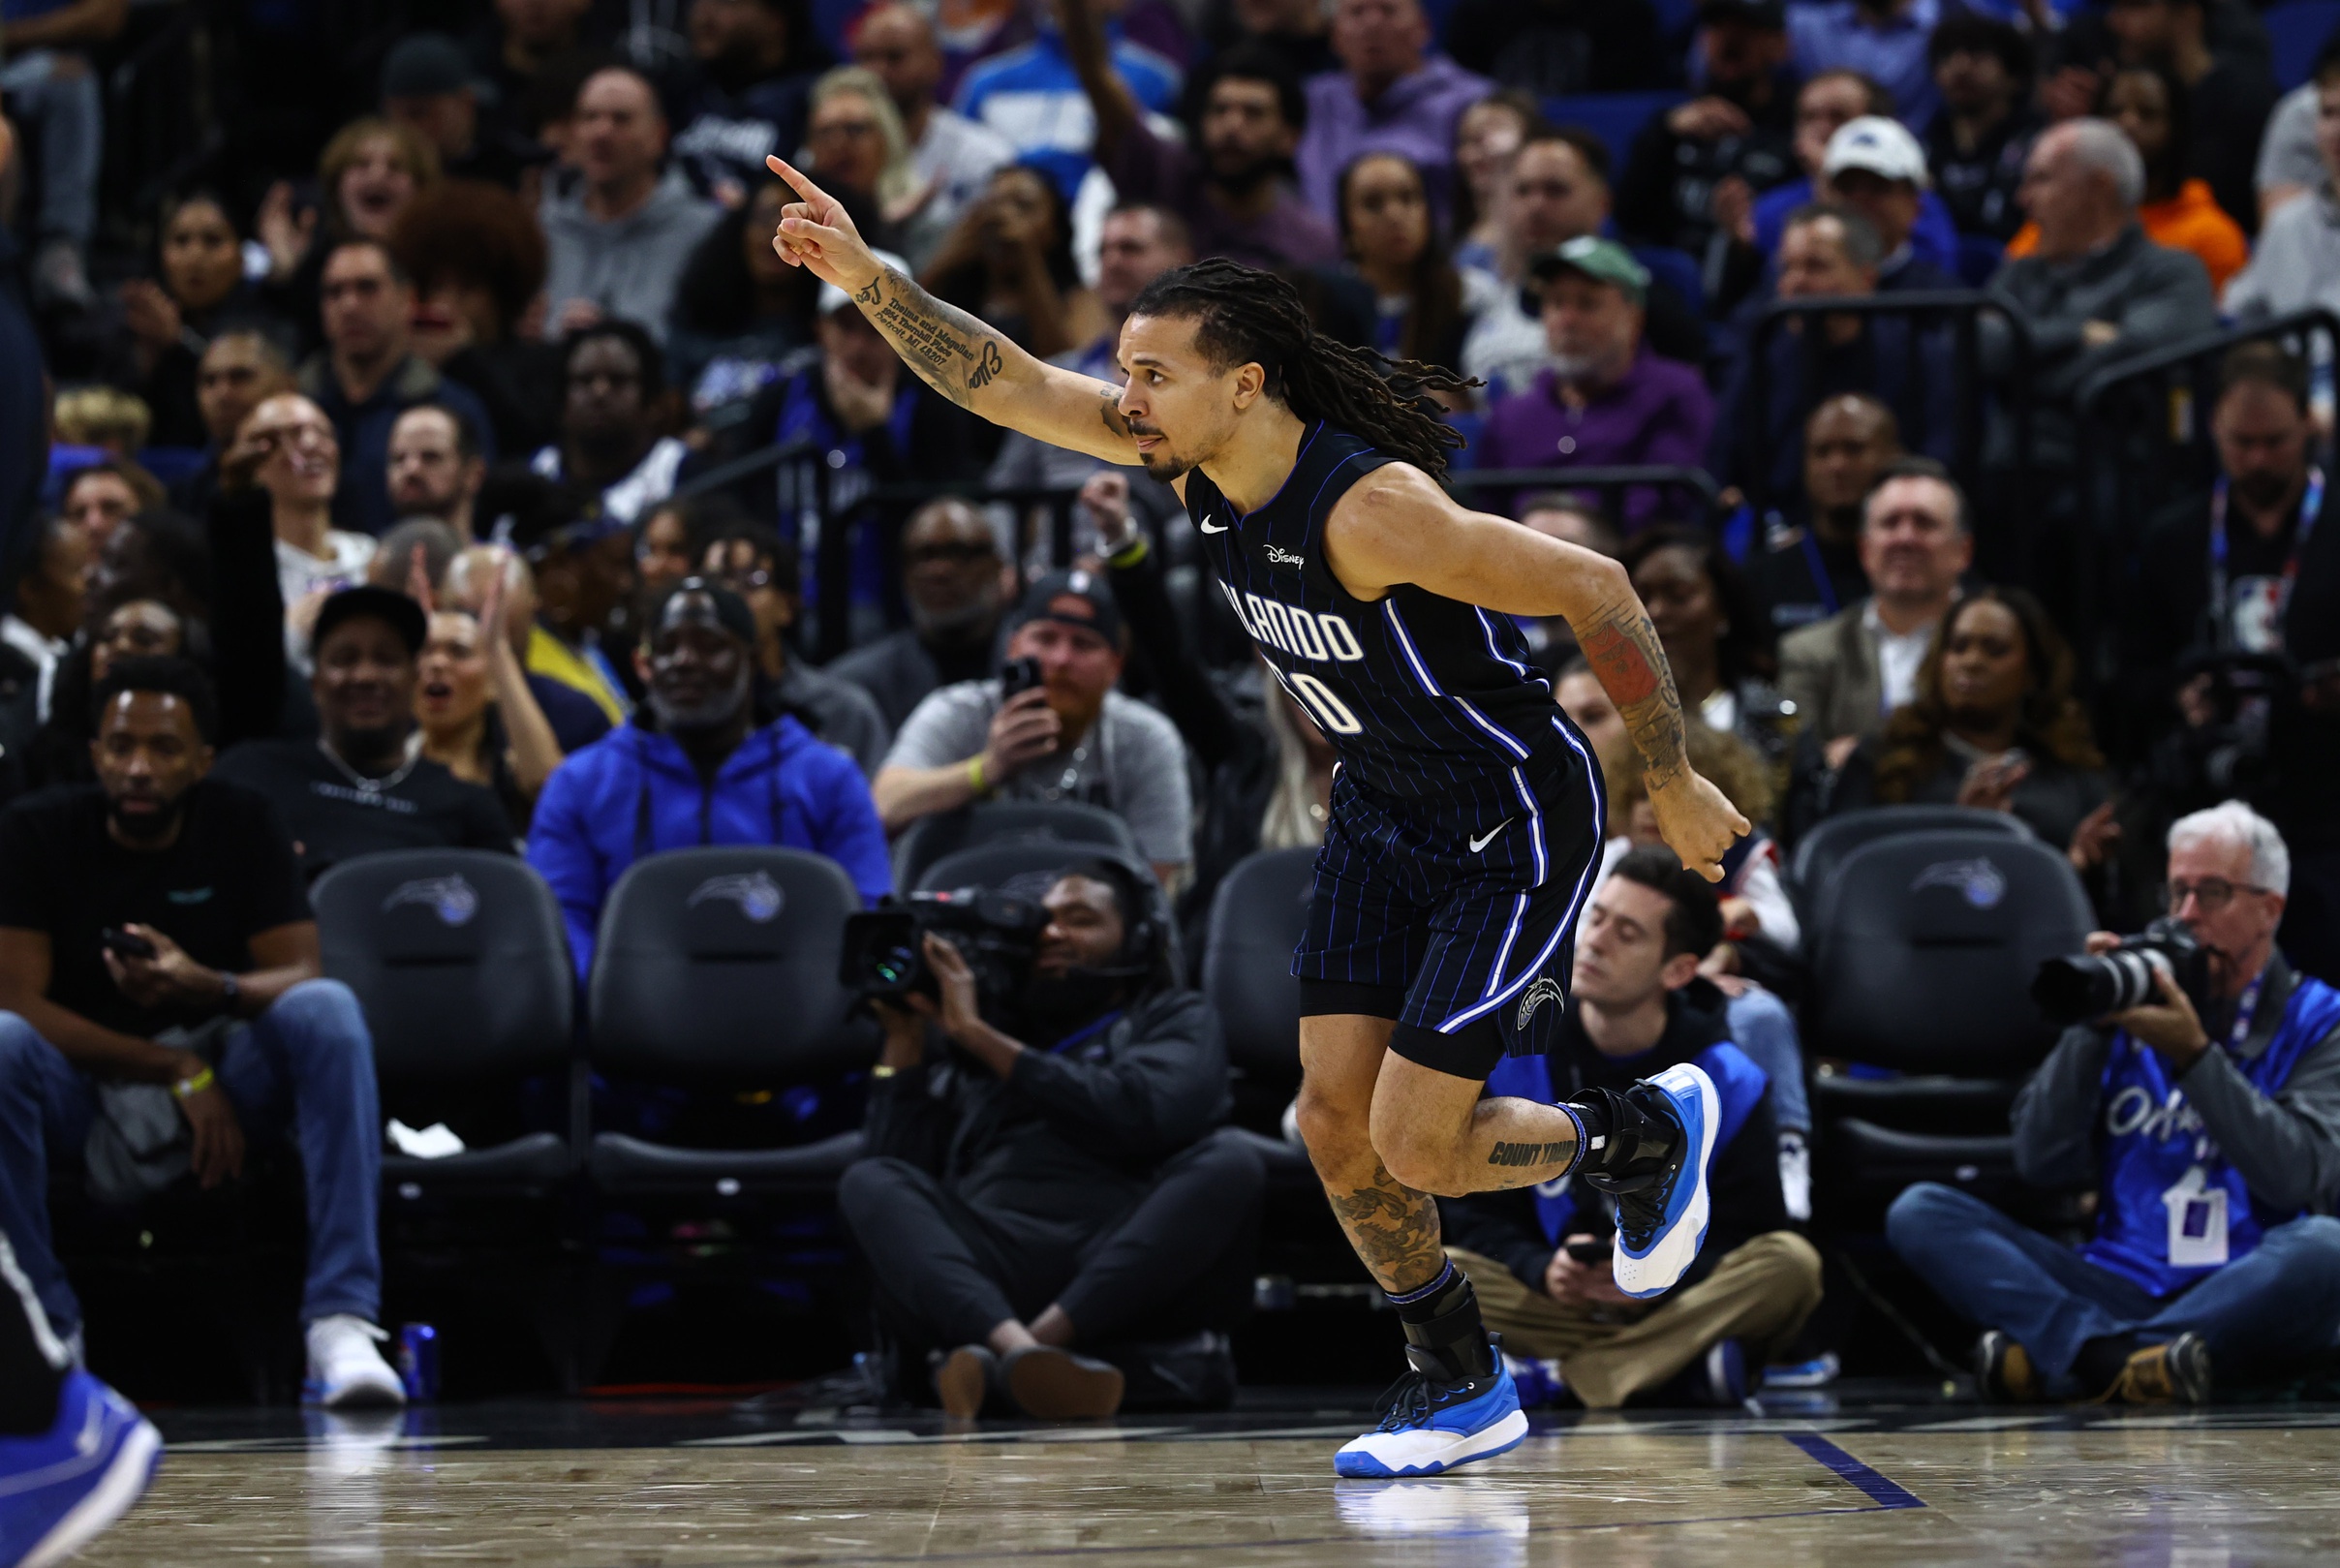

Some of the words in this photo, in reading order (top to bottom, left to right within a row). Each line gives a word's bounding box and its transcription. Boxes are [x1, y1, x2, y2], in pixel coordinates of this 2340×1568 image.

[874, 312, 904, 339] Detroit,
[906, 334, 923, 349] MI
[919, 345, 947, 366] 48207
[881, 307, 899, 322] 1954
[898, 317, 931, 343] Thornhill
[930, 339, 953, 357] Place
[888, 297, 919, 326] Thelma
[920, 320, 939, 335] and
[935, 328, 974, 361] Magellan
[969, 340, 1002, 389] Ella
[1488, 1141, 1542, 1167] COUNT
